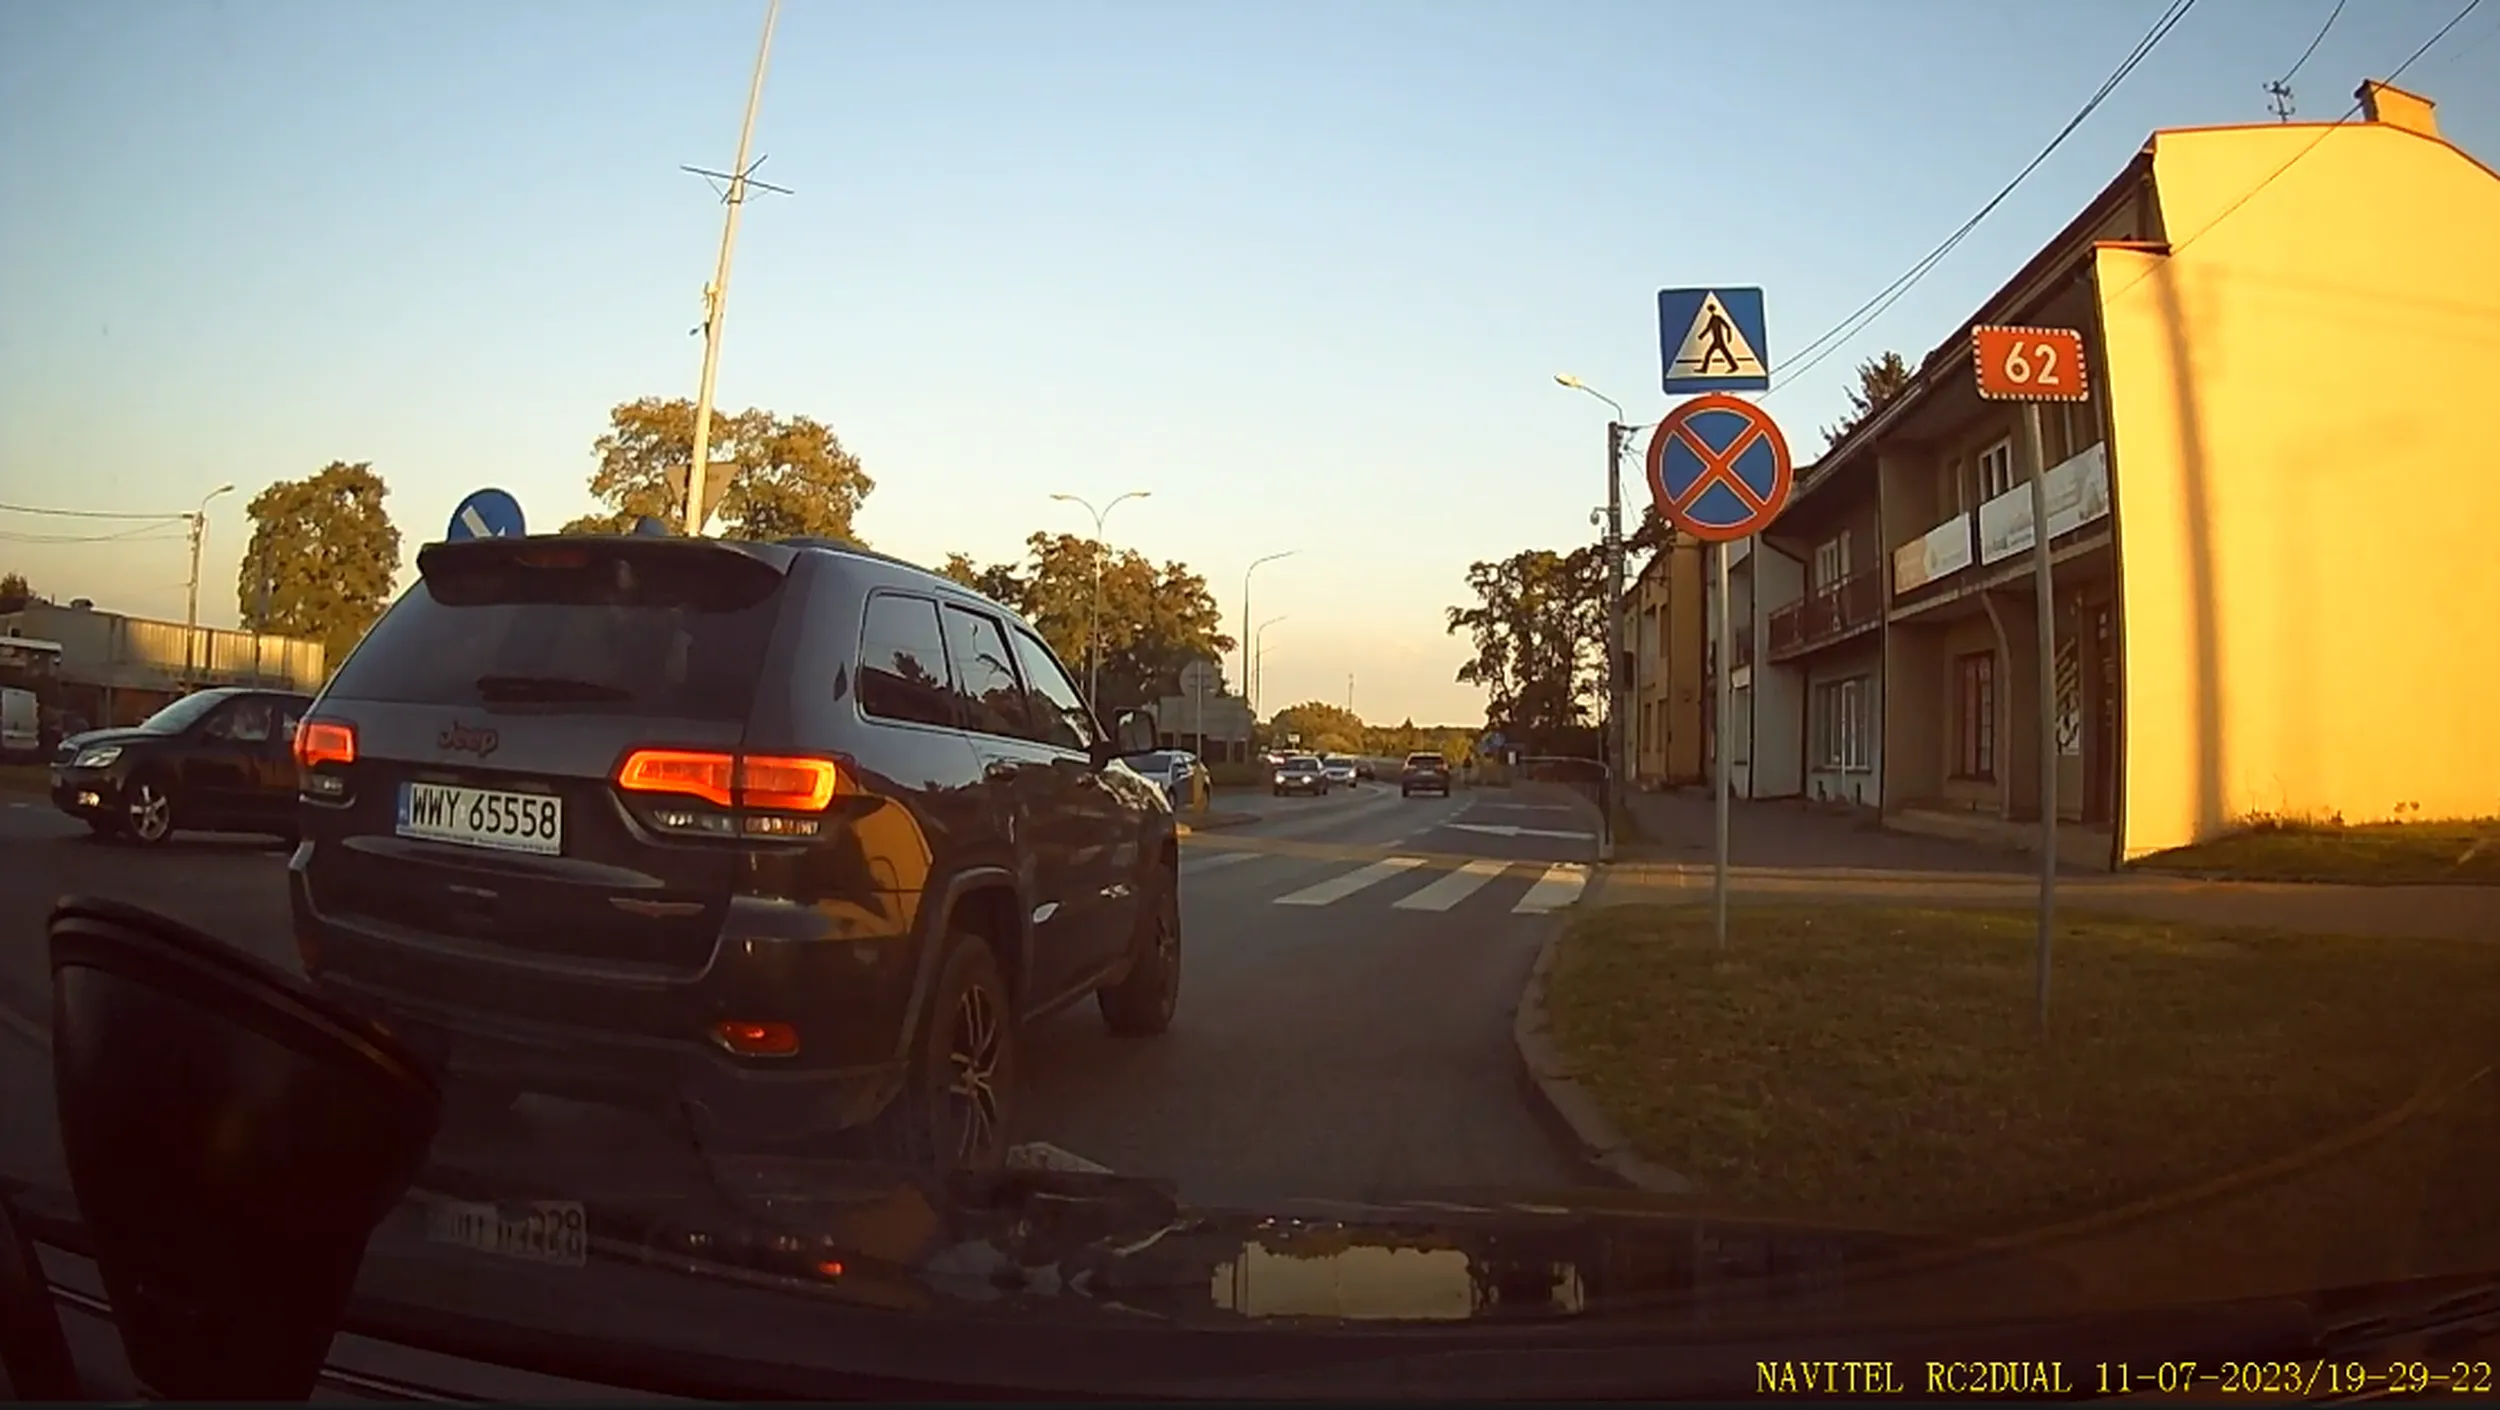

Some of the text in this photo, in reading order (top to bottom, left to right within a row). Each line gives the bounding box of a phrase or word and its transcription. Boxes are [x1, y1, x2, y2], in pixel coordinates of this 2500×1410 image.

[2004, 341, 2060, 385] 62
[437, 720, 499, 759] Jeep
[411, 786, 461, 828] WWY
[469, 793, 556, 840] 65558
